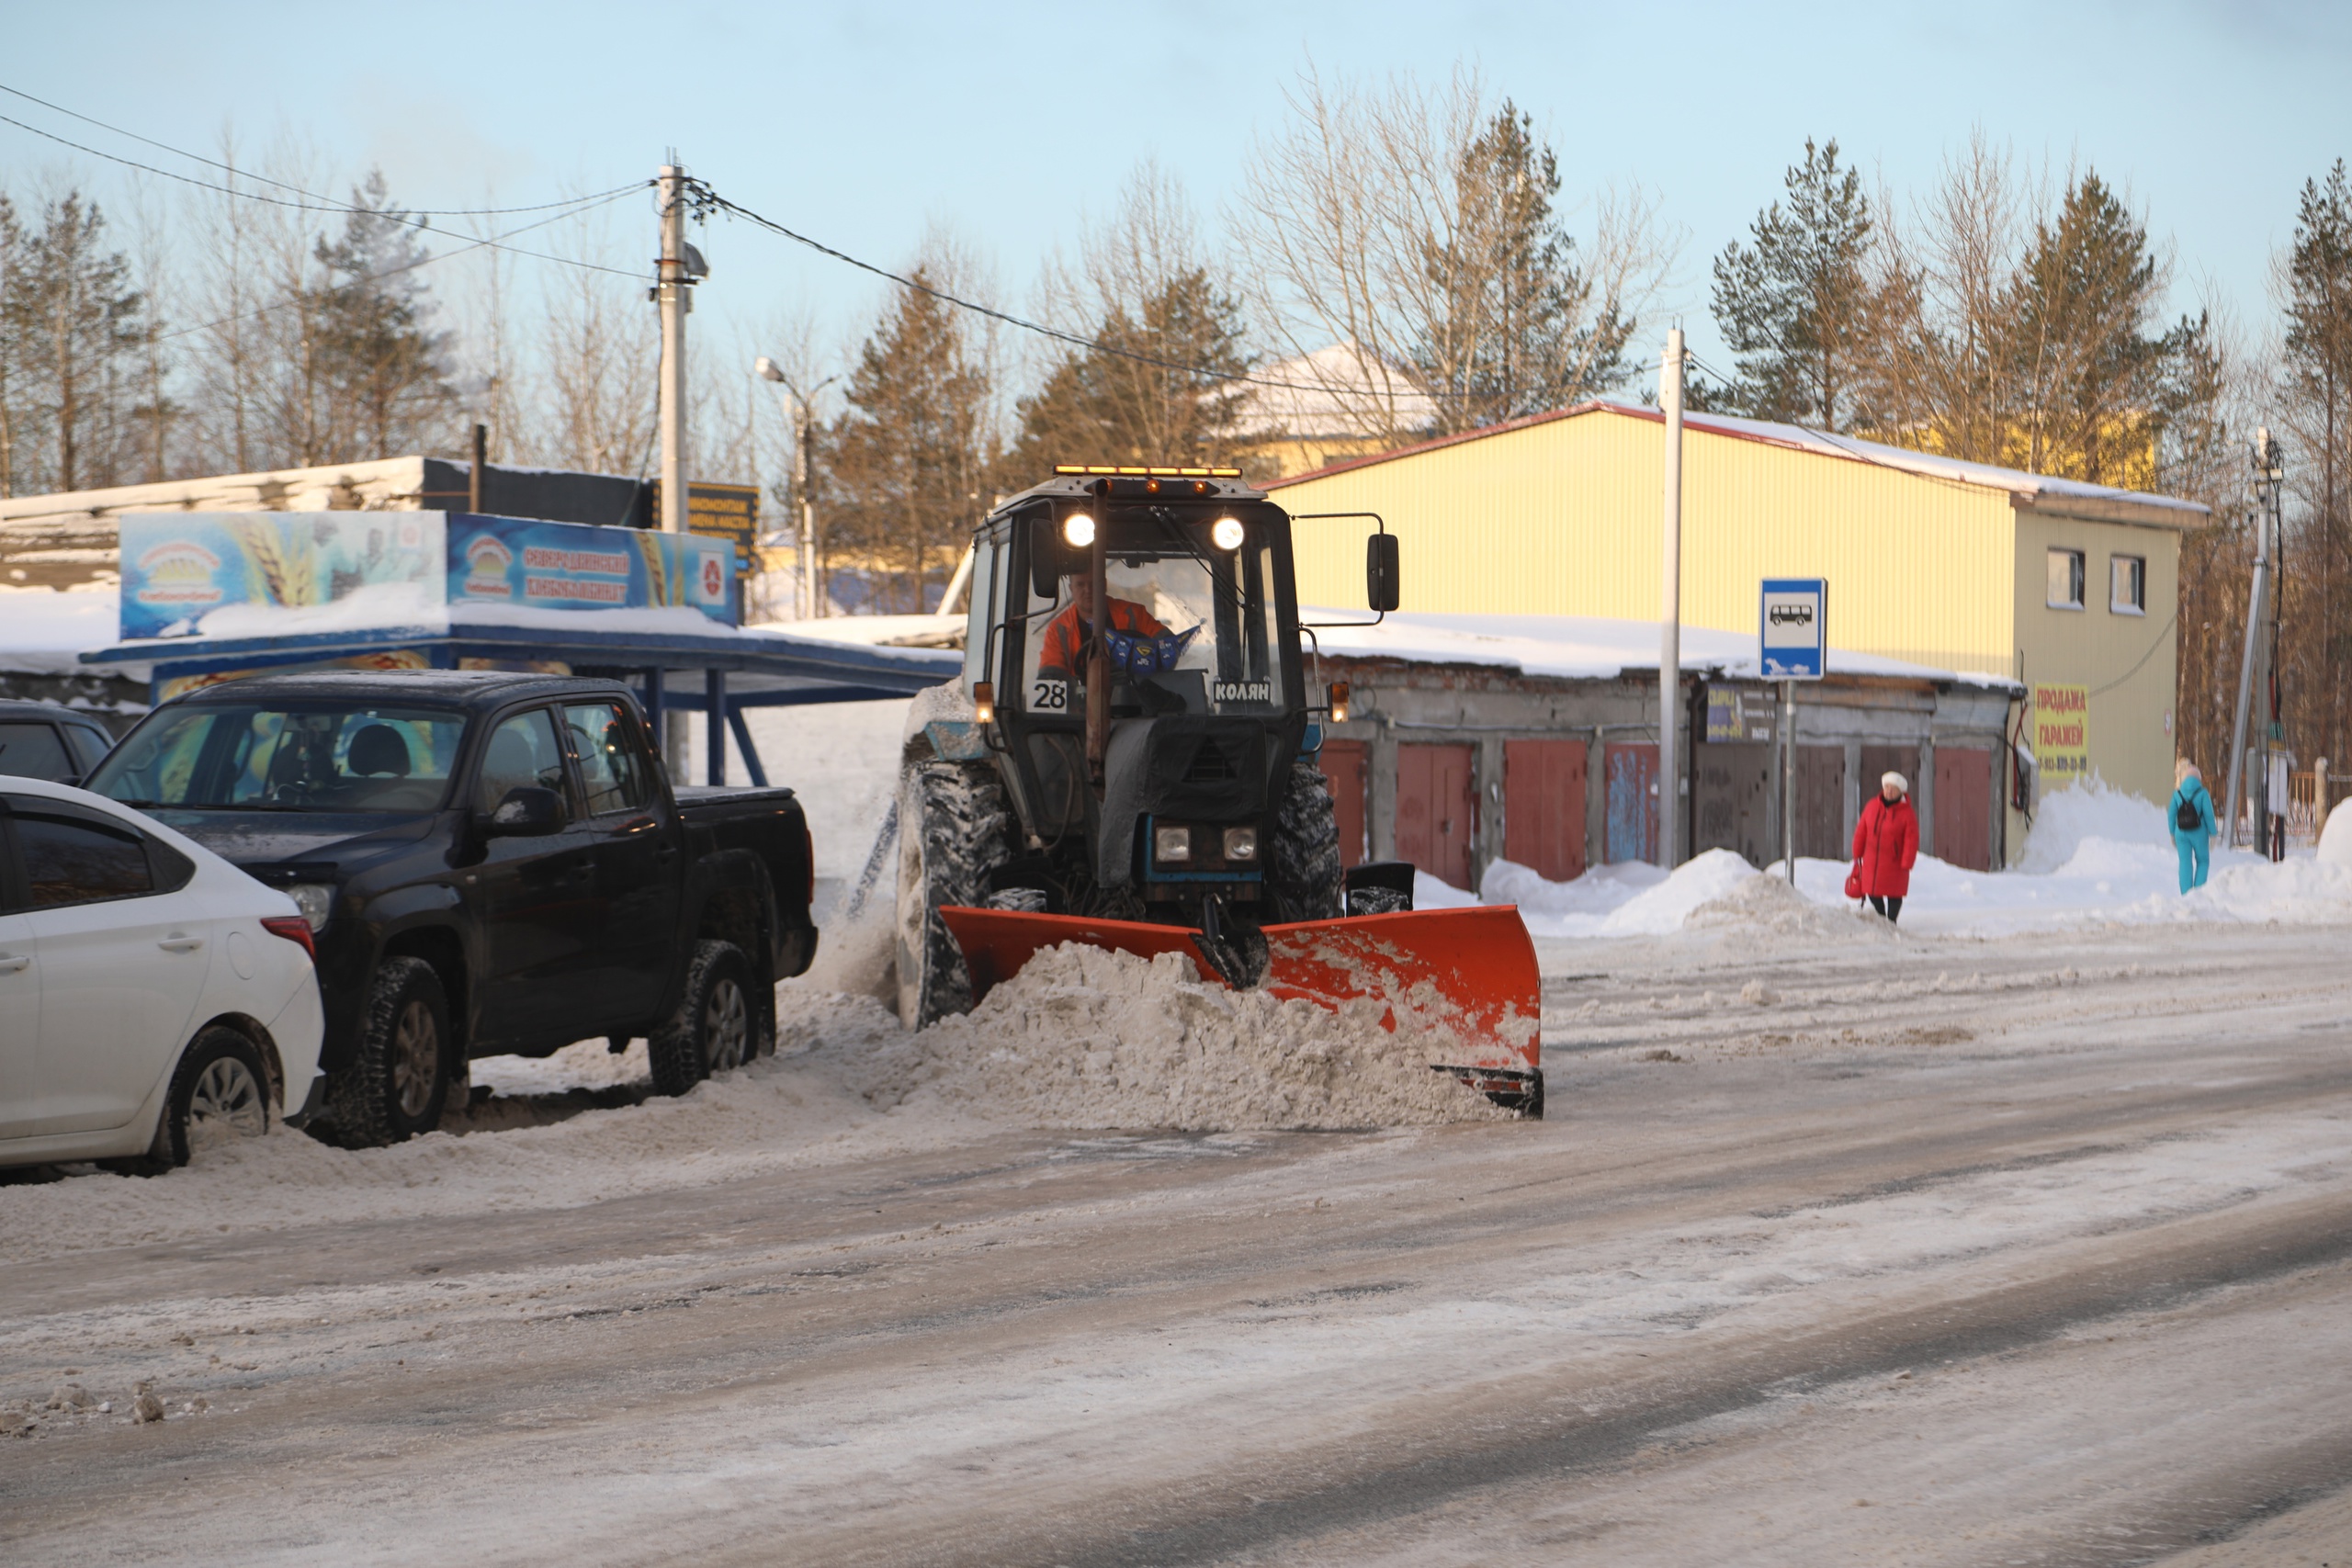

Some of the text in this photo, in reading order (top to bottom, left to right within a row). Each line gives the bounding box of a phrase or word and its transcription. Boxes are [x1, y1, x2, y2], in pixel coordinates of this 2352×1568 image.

[1034, 683, 1066, 708] 28
[1216, 683, 1270, 700] КОЛЯН
[2037, 689, 2086, 715] ПРОДАЖА
[2039, 716, 2084, 746] ГАРАЖЕЙ
